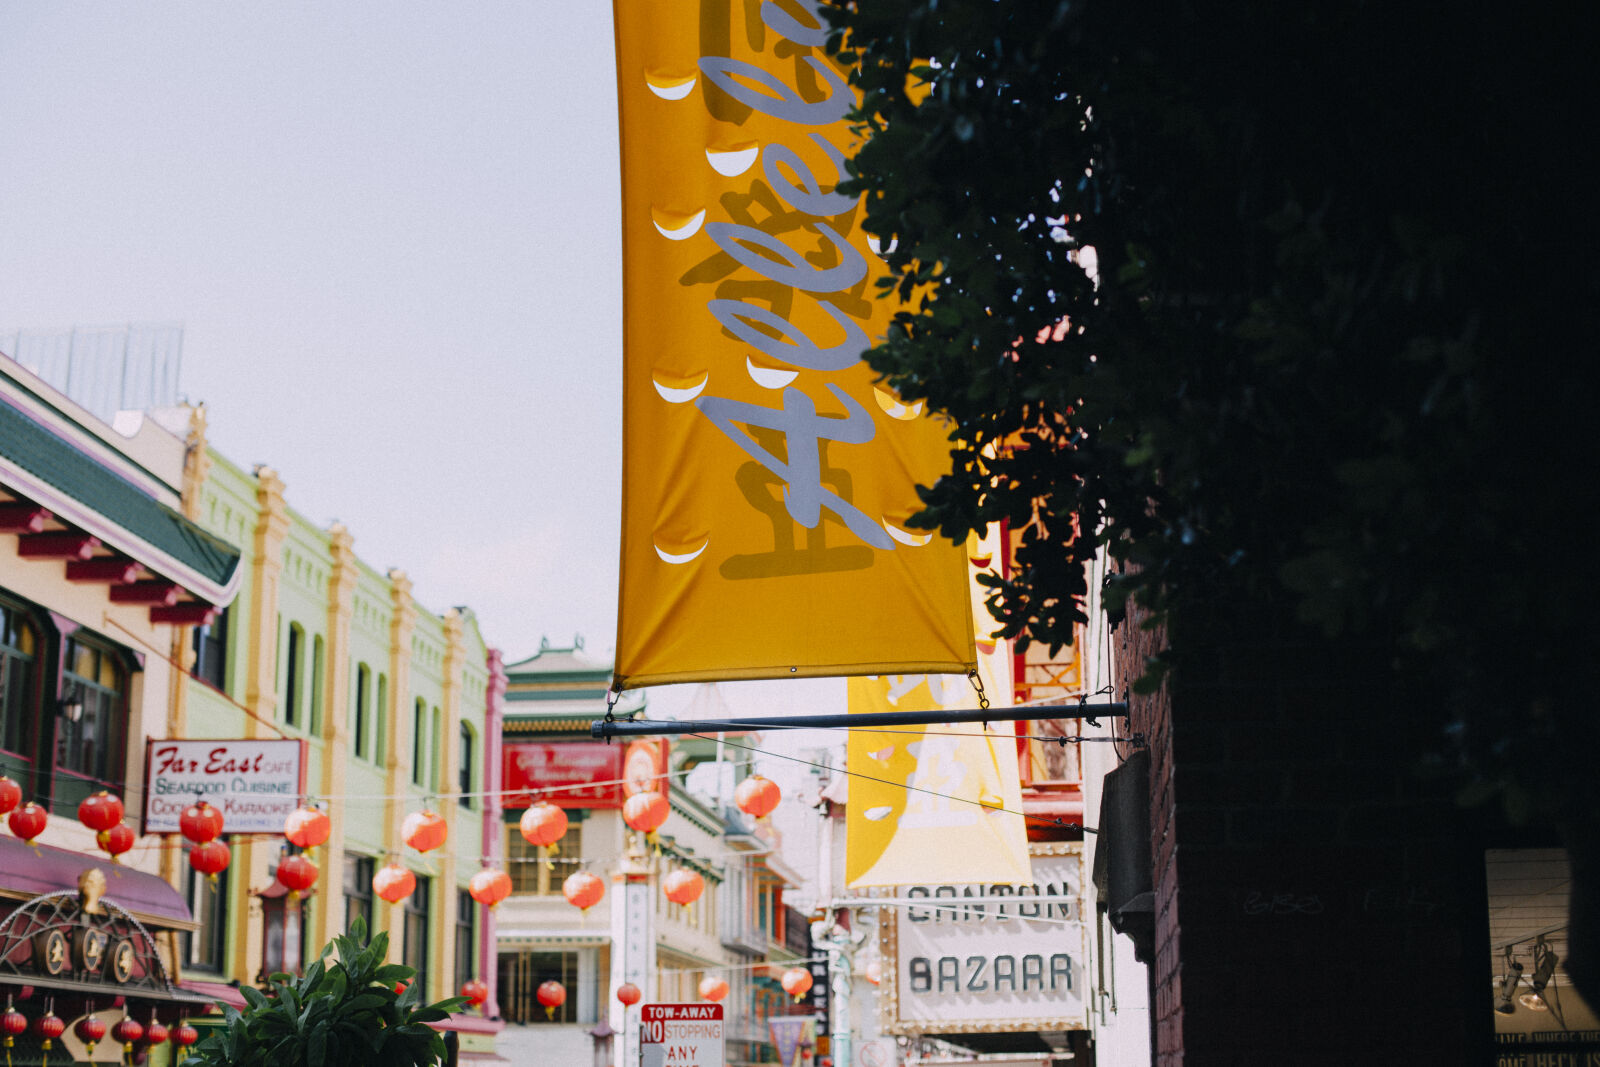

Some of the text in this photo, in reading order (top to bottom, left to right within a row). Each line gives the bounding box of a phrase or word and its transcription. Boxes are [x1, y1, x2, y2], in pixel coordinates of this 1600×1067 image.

[156, 747, 198, 775] Far
[204, 748, 264, 775] East
[907, 882, 1071, 922] CANTON
[909, 953, 1072, 993] BAZAAR
[648, 1006, 716, 1019] TOW-AWAY
[642, 1020, 721, 1042] NO STOPPING
[667, 1045, 698, 1061] ANY
